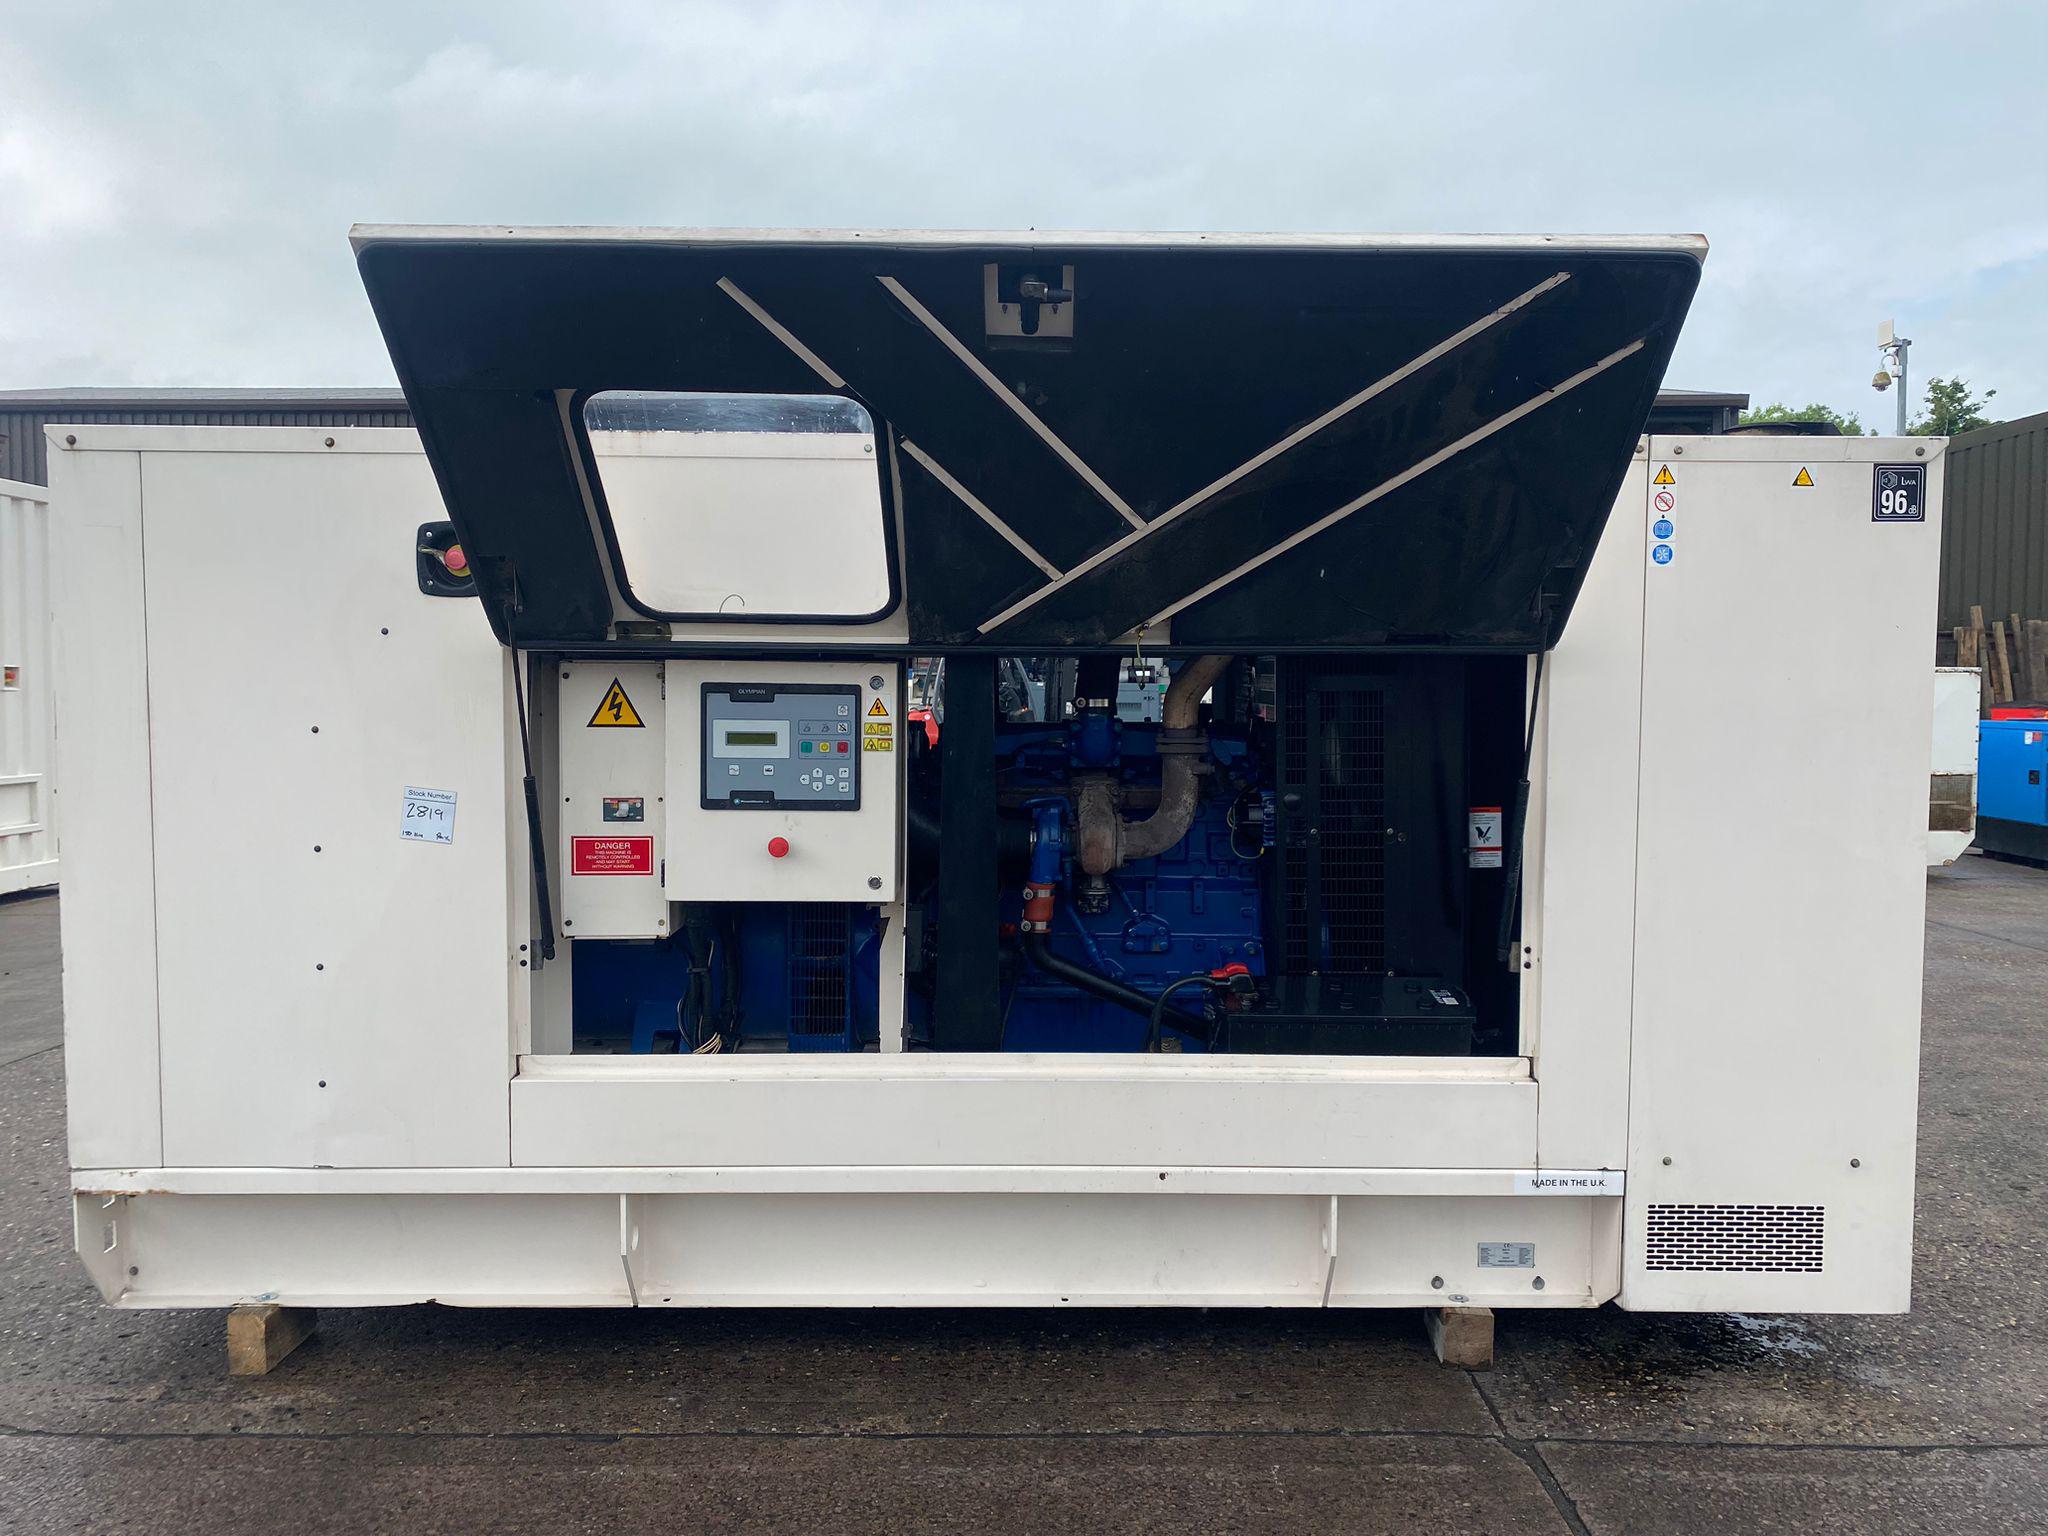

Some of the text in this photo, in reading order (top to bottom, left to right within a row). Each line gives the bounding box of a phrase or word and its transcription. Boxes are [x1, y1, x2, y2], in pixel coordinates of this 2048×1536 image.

[1881, 489, 1917, 515] 96 dB
[408, 789, 453, 800] Stock Number
[406, 802, 444, 821] 2819
[594, 842, 631, 850] DANGER
[1531, 1179, 1607, 1188] MADE IN THE U.K.
